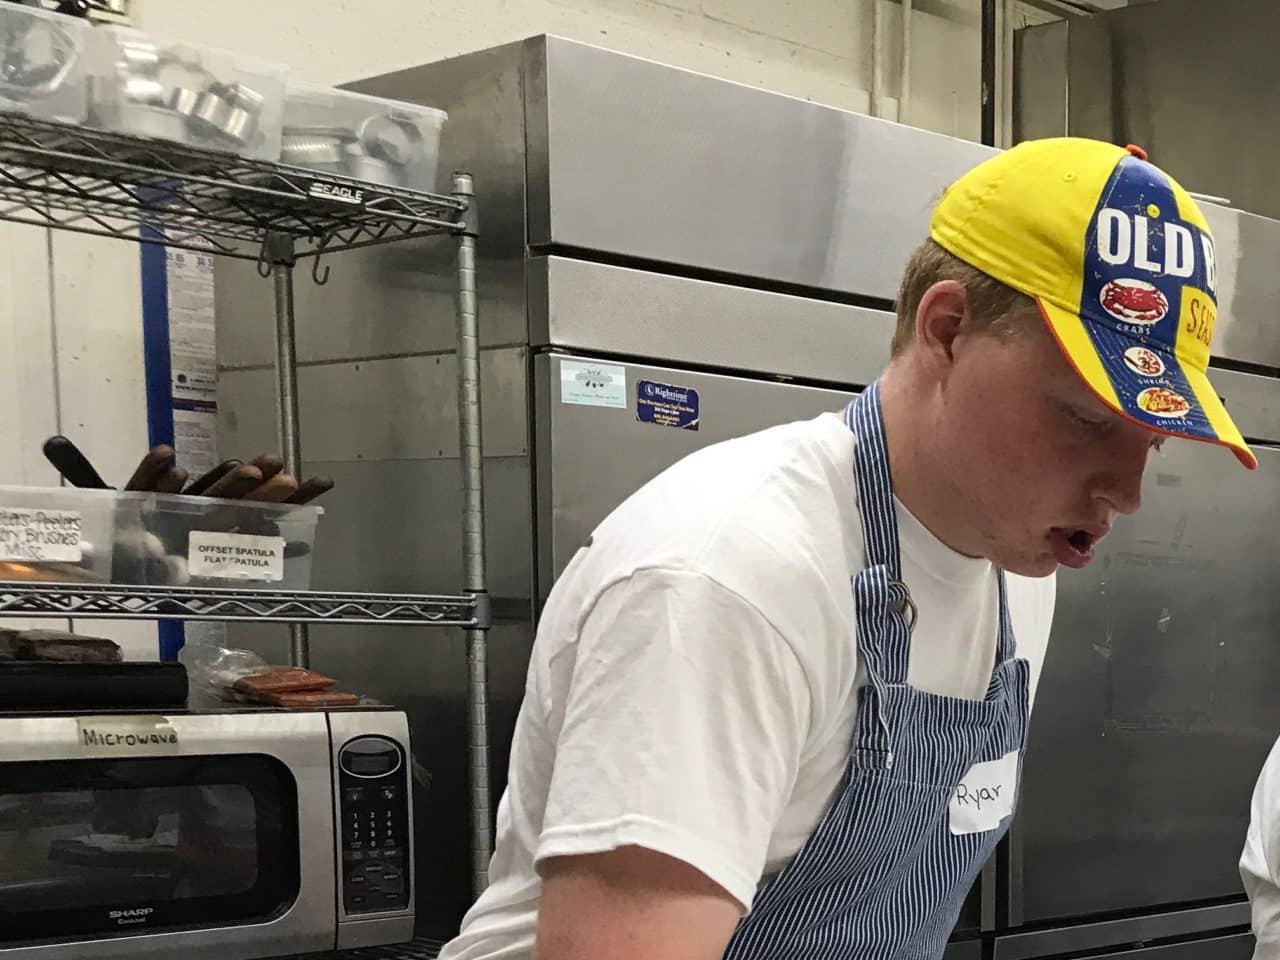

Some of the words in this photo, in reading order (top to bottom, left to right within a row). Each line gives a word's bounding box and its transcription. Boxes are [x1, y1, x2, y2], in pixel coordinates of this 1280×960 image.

[322, 184, 364, 201] EAGLE
[1097, 207, 1195, 278] OLD
[1116, 323, 1151, 335] CRABS
[198, 545, 233, 554] OFFSET
[236, 547, 275, 557] SPATULA
[82, 728, 178, 746] Microwave
[109, 907, 153, 918] SHARP
